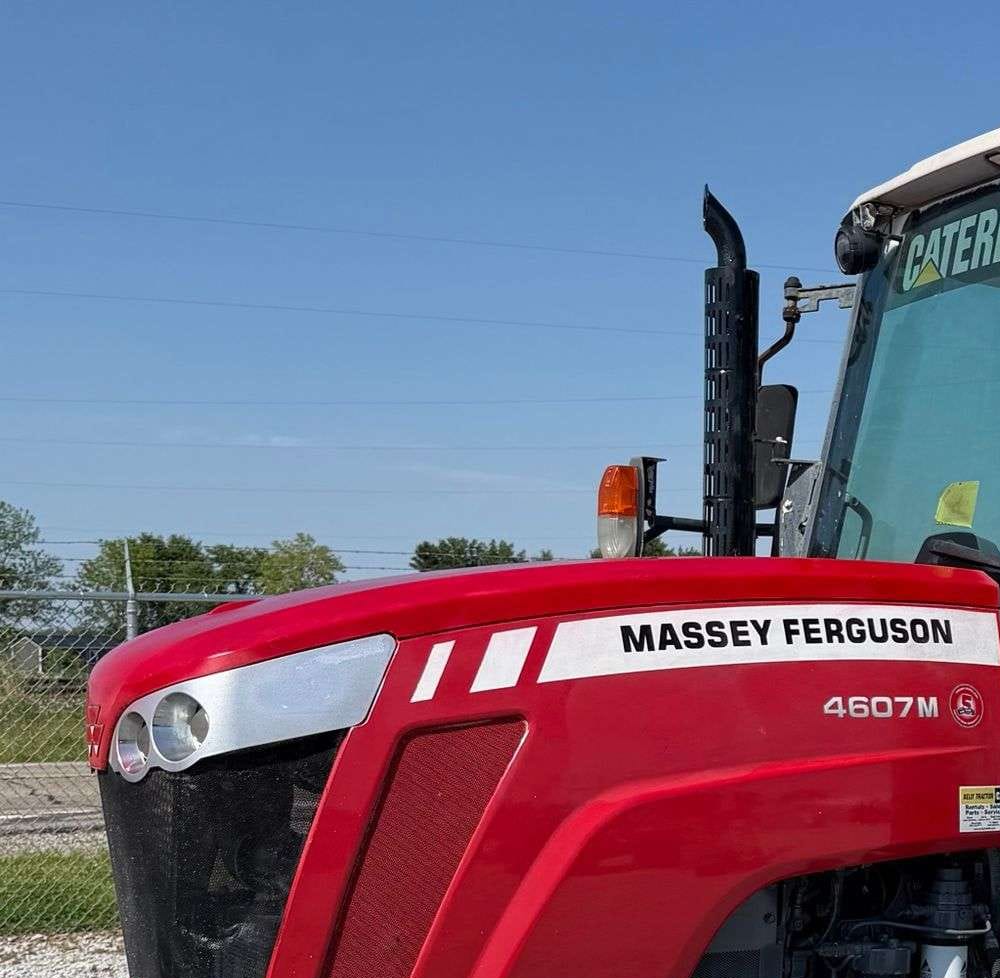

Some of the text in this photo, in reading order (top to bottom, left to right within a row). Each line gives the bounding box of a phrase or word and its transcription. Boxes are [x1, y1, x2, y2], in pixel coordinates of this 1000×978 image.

[620, 617, 954, 653] MASSEY FERGUSON
[822, 696, 939, 718] 4607M
